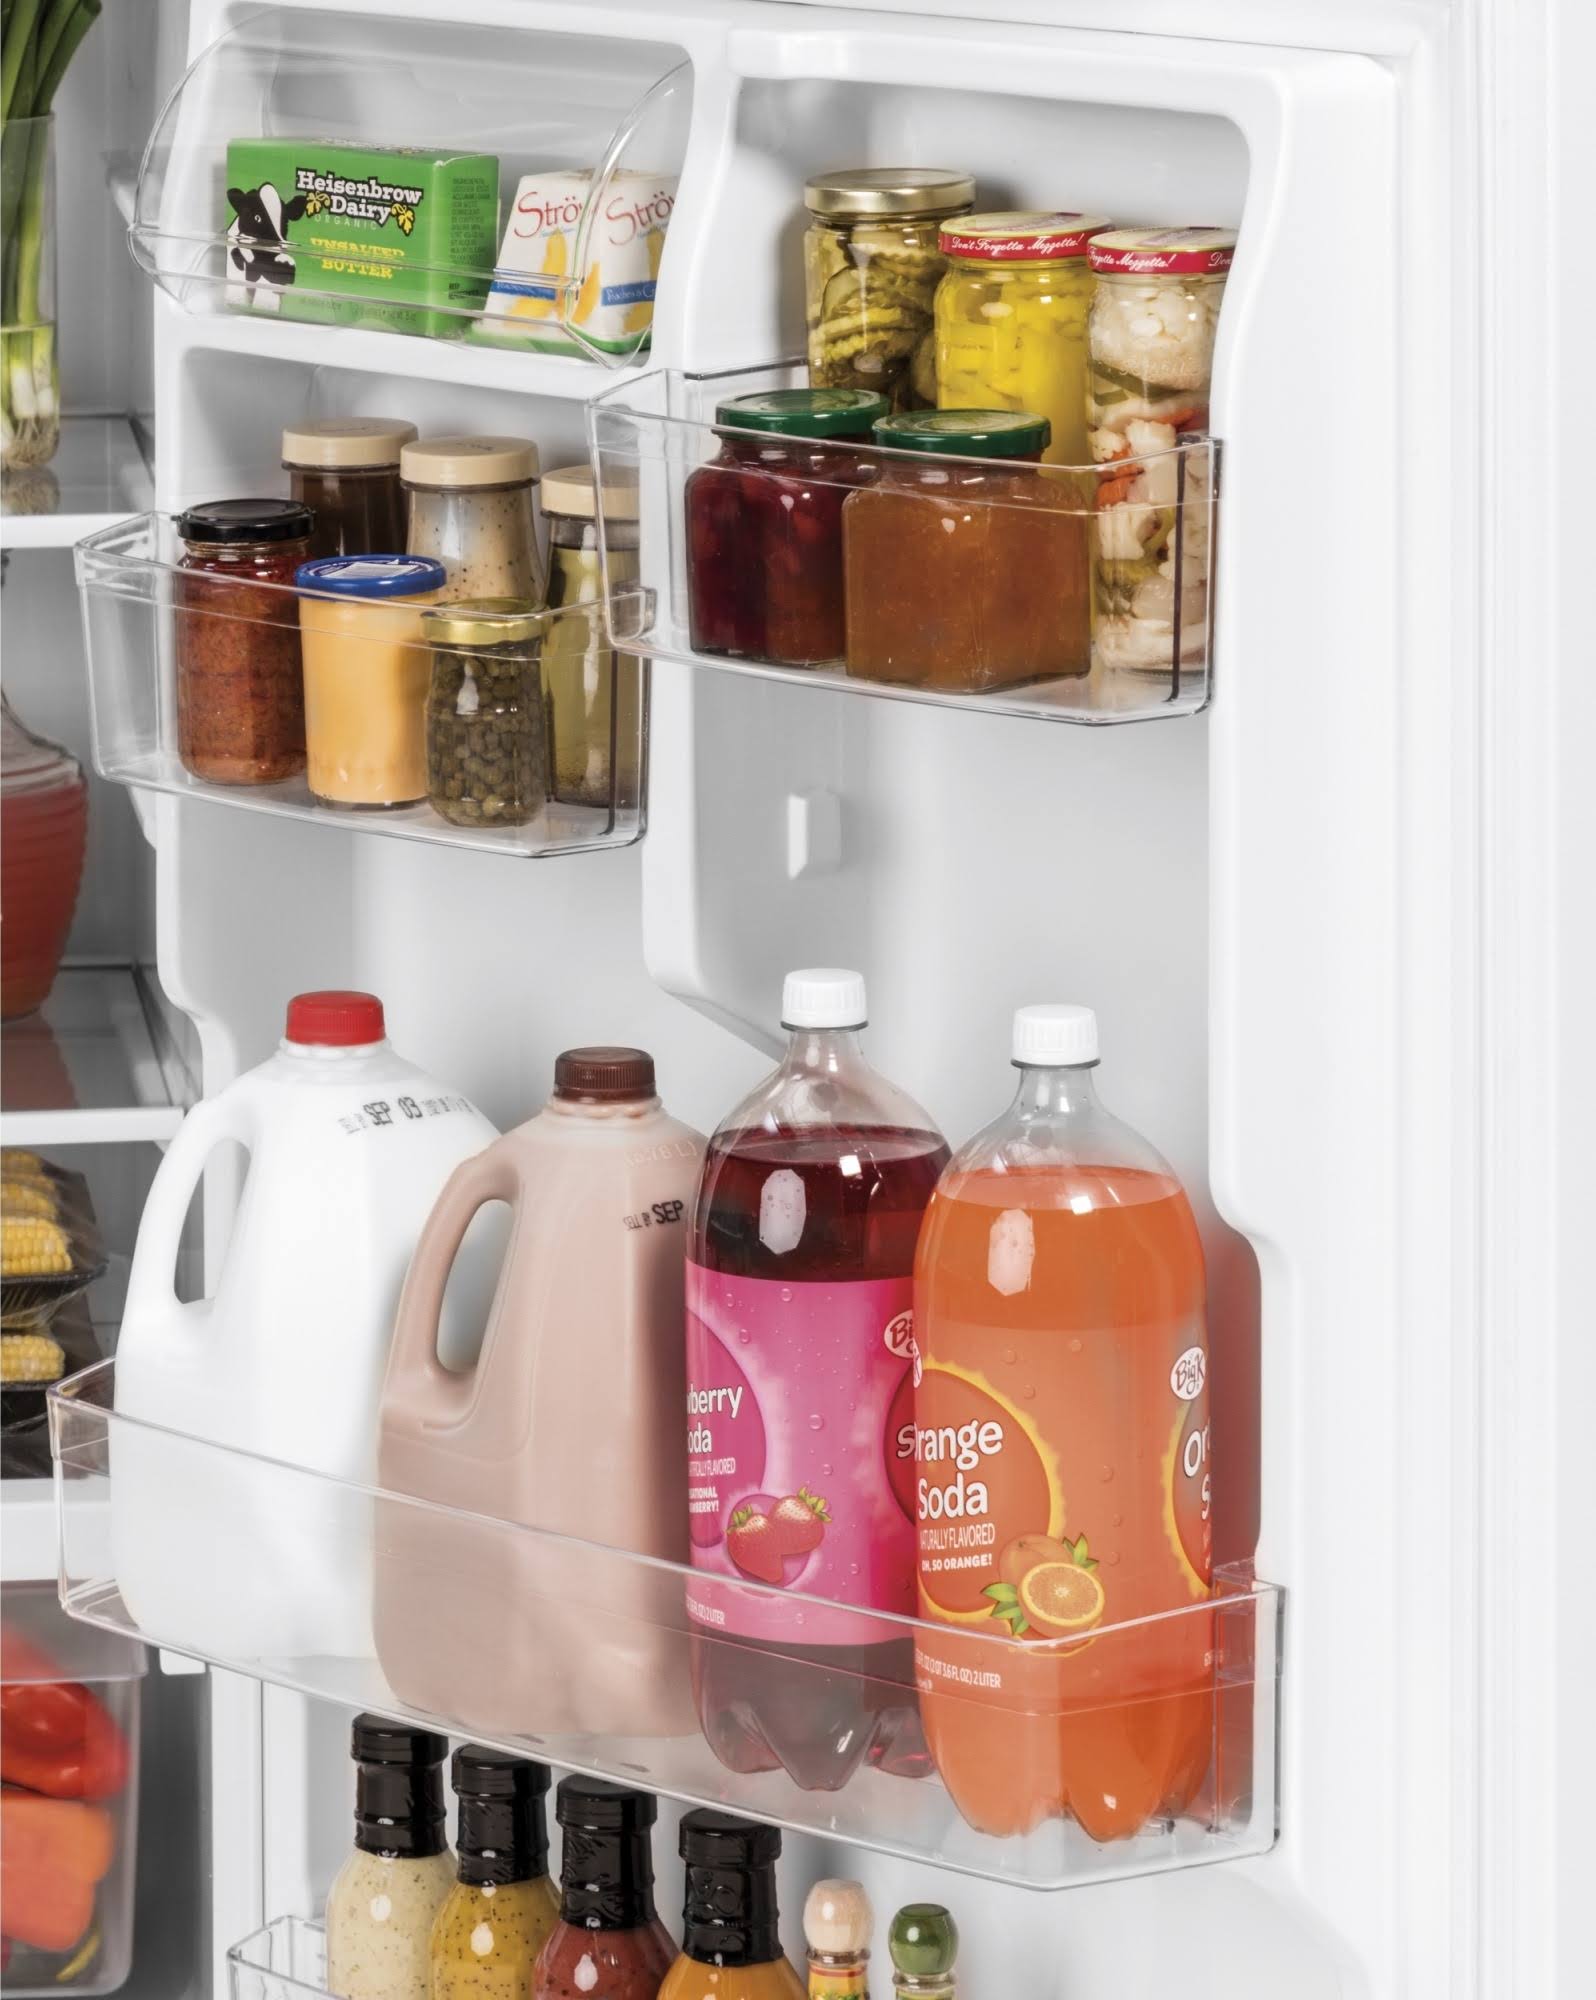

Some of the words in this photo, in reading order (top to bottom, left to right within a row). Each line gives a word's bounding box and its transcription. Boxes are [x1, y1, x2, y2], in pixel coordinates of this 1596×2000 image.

[296, 169, 423, 205] Heisenbrow
[314, 213, 378, 231] ORGANIC
[329, 195, 392, 224] Dairy
[514, 191, 583, 238] Strö
[606, 191, 675, 246] Strö
[320, 258, 393, 280] BUTTER
[363, 1101, 393, 1126] SEP
[652, 1199, 683, 1224] SEP
[687, 1421, 712, 1454] oda
[918, 1472, 989, 1520] Soda
[949, 1522, 996, 1549] FLAVORED
[944, 1553, 992, 1571] ORANGE!
[980, 1671, 1001, 1688] LITER
